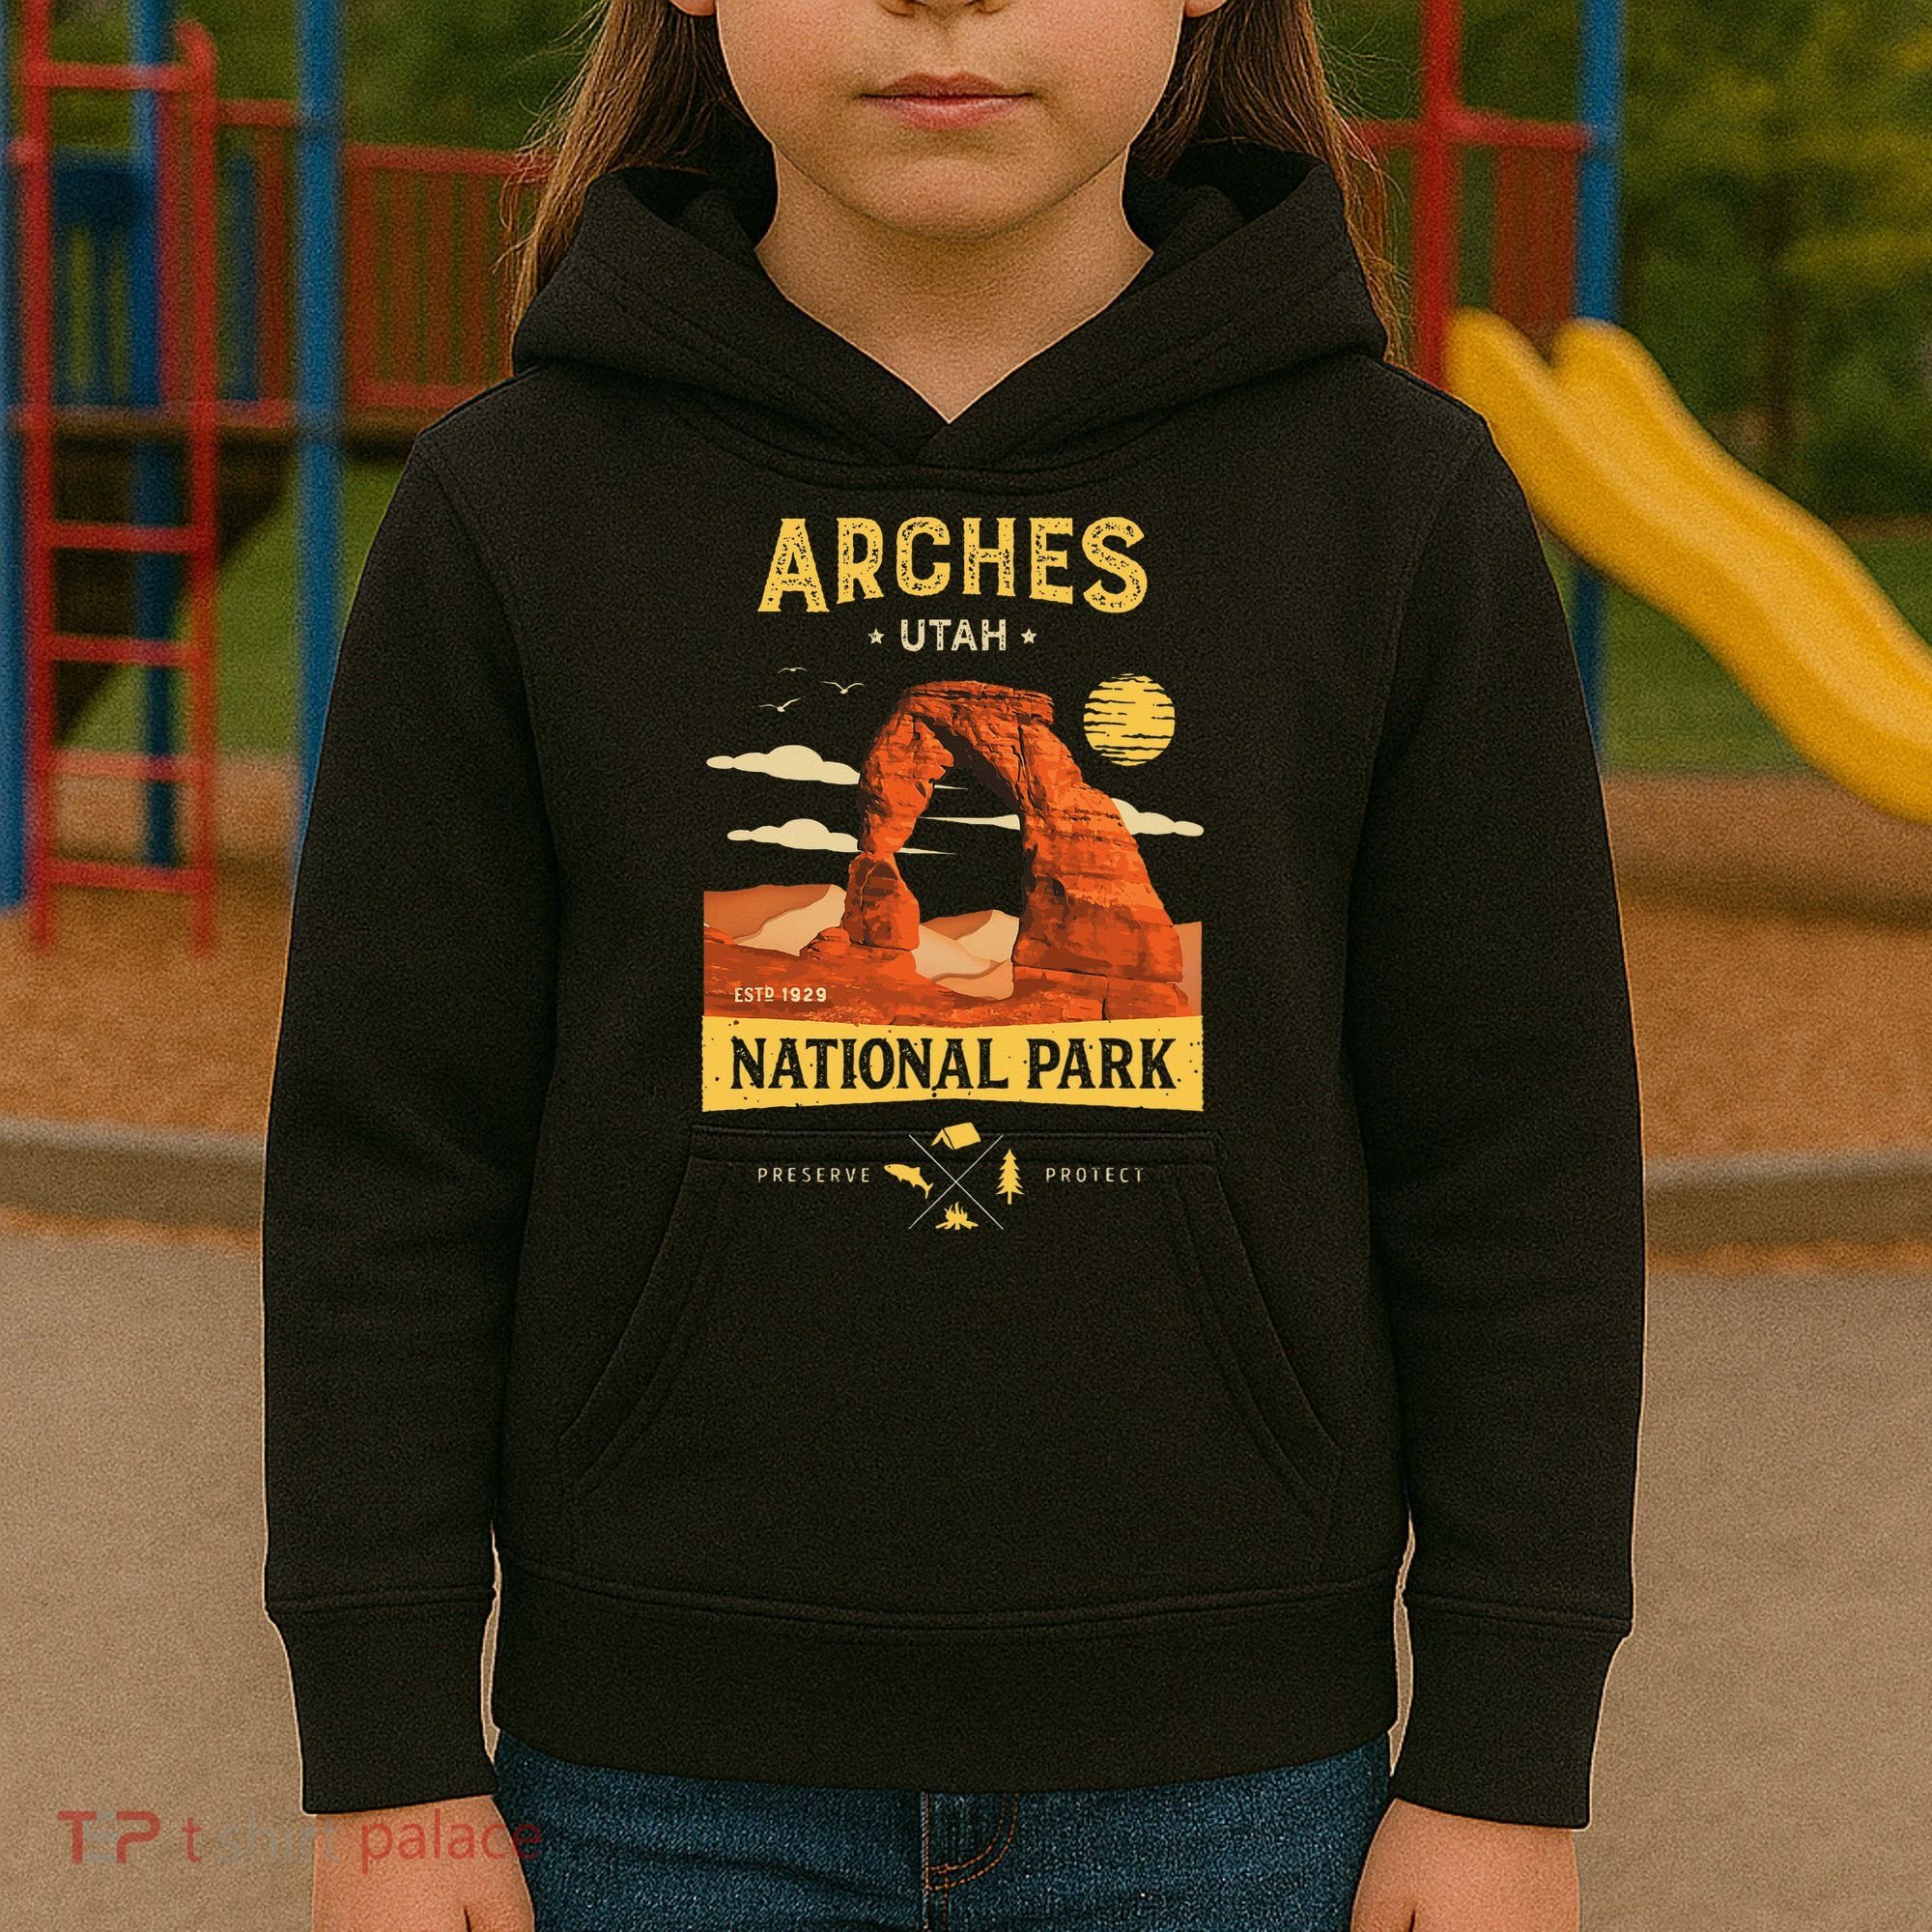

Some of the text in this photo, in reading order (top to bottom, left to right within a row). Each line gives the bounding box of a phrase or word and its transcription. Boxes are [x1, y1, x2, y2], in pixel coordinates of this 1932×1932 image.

[757, 517, 1148, 613] ARCHES
[900, 619, 1007, 652] UTAH
[781, 986, 827, 1003] 1929
[730, 1037, 1177, 1090] NATIONAL PARK
[758, 1167, 870, 1183] PRESERVE
[1046, 1167, 1145, 1183] PROTECT
